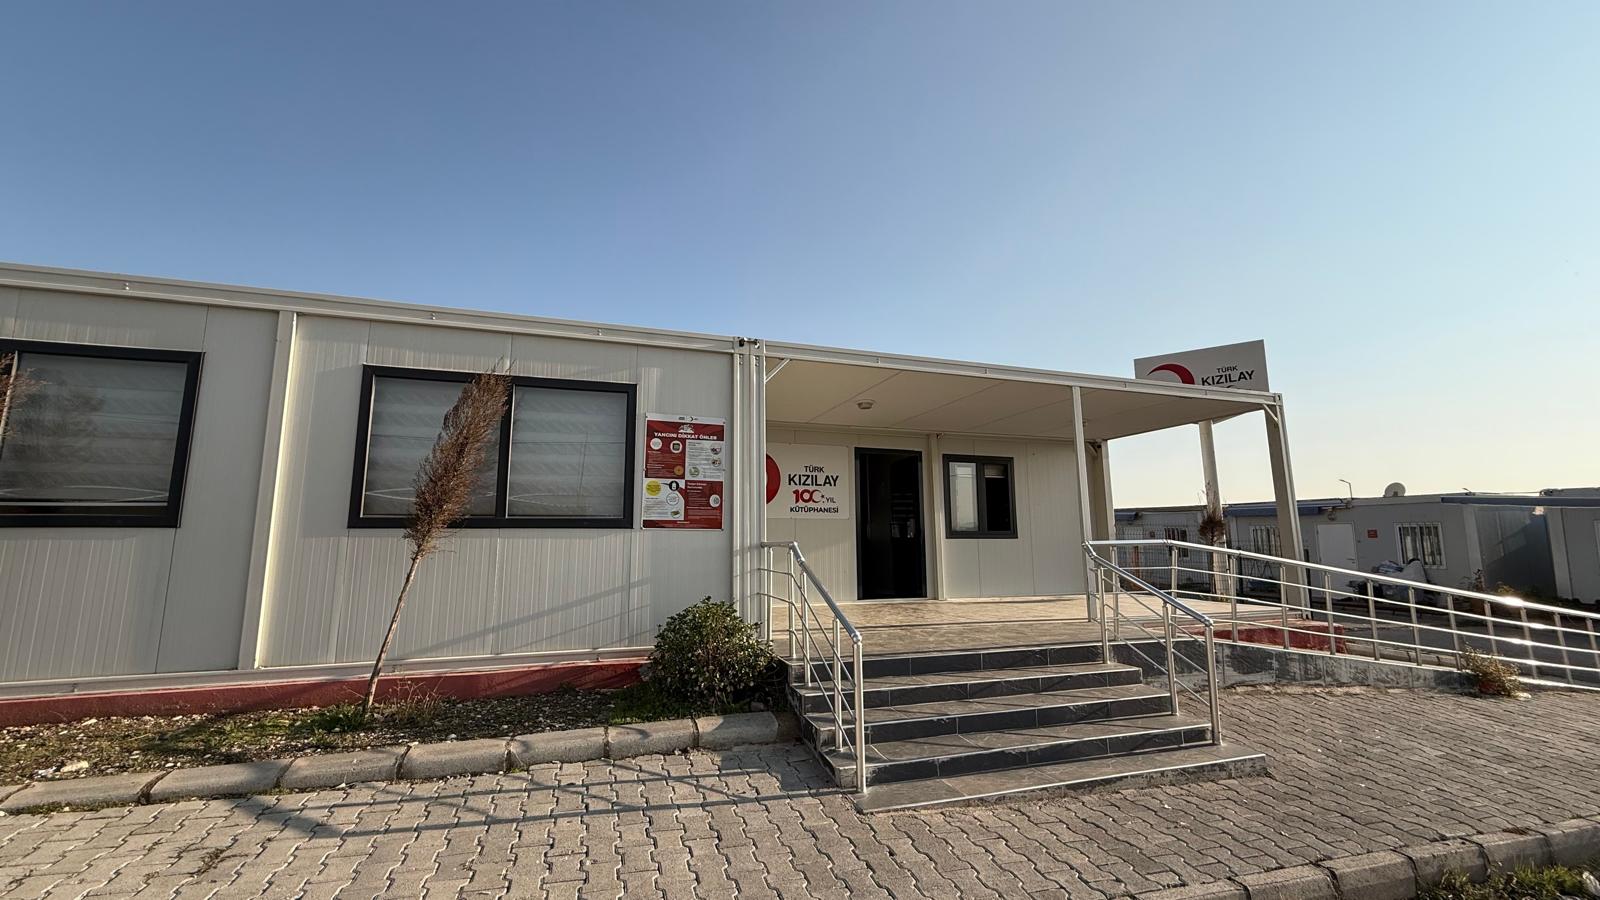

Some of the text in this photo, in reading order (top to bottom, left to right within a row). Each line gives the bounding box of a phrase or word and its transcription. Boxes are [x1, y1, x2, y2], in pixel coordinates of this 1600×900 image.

[1201, 370, 1254, 386] KIZILAY
[804, 465, 824, 473] TÜRK
[788, 474, 839, 487] KIZILAY
